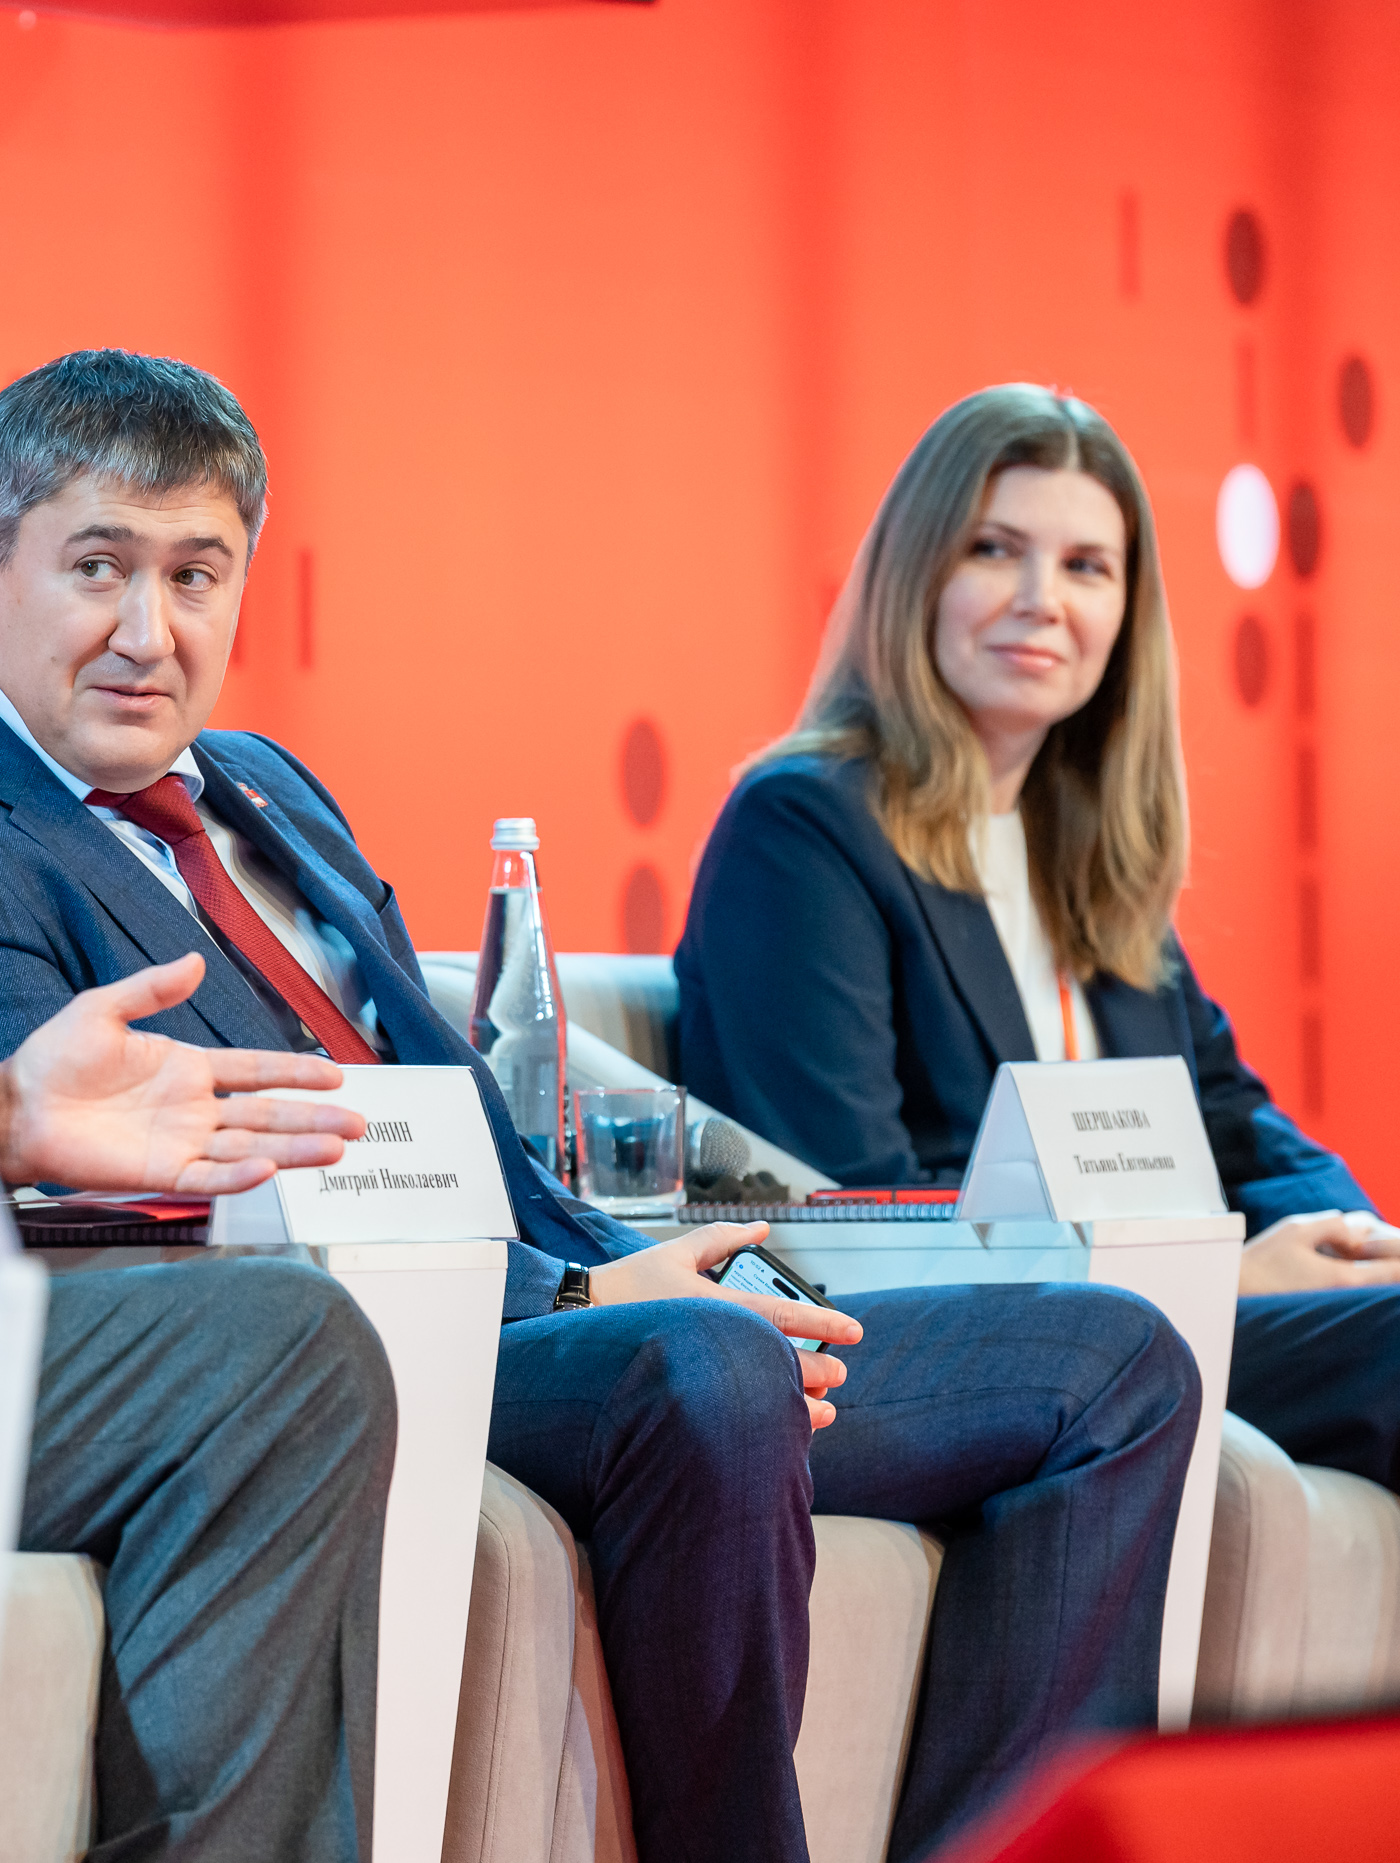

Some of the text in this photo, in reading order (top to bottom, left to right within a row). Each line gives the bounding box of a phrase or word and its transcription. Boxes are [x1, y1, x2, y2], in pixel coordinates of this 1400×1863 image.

[1071, 1108, 1151, 1132] ШЕРШАКОВА
[344, 1121, 414, 1143] ОНИН
[1073, 1152, 1176, 1174] Татьяна Евгеньевна
[318, 1167, 460, 1197] Дмитрий Николаевич
